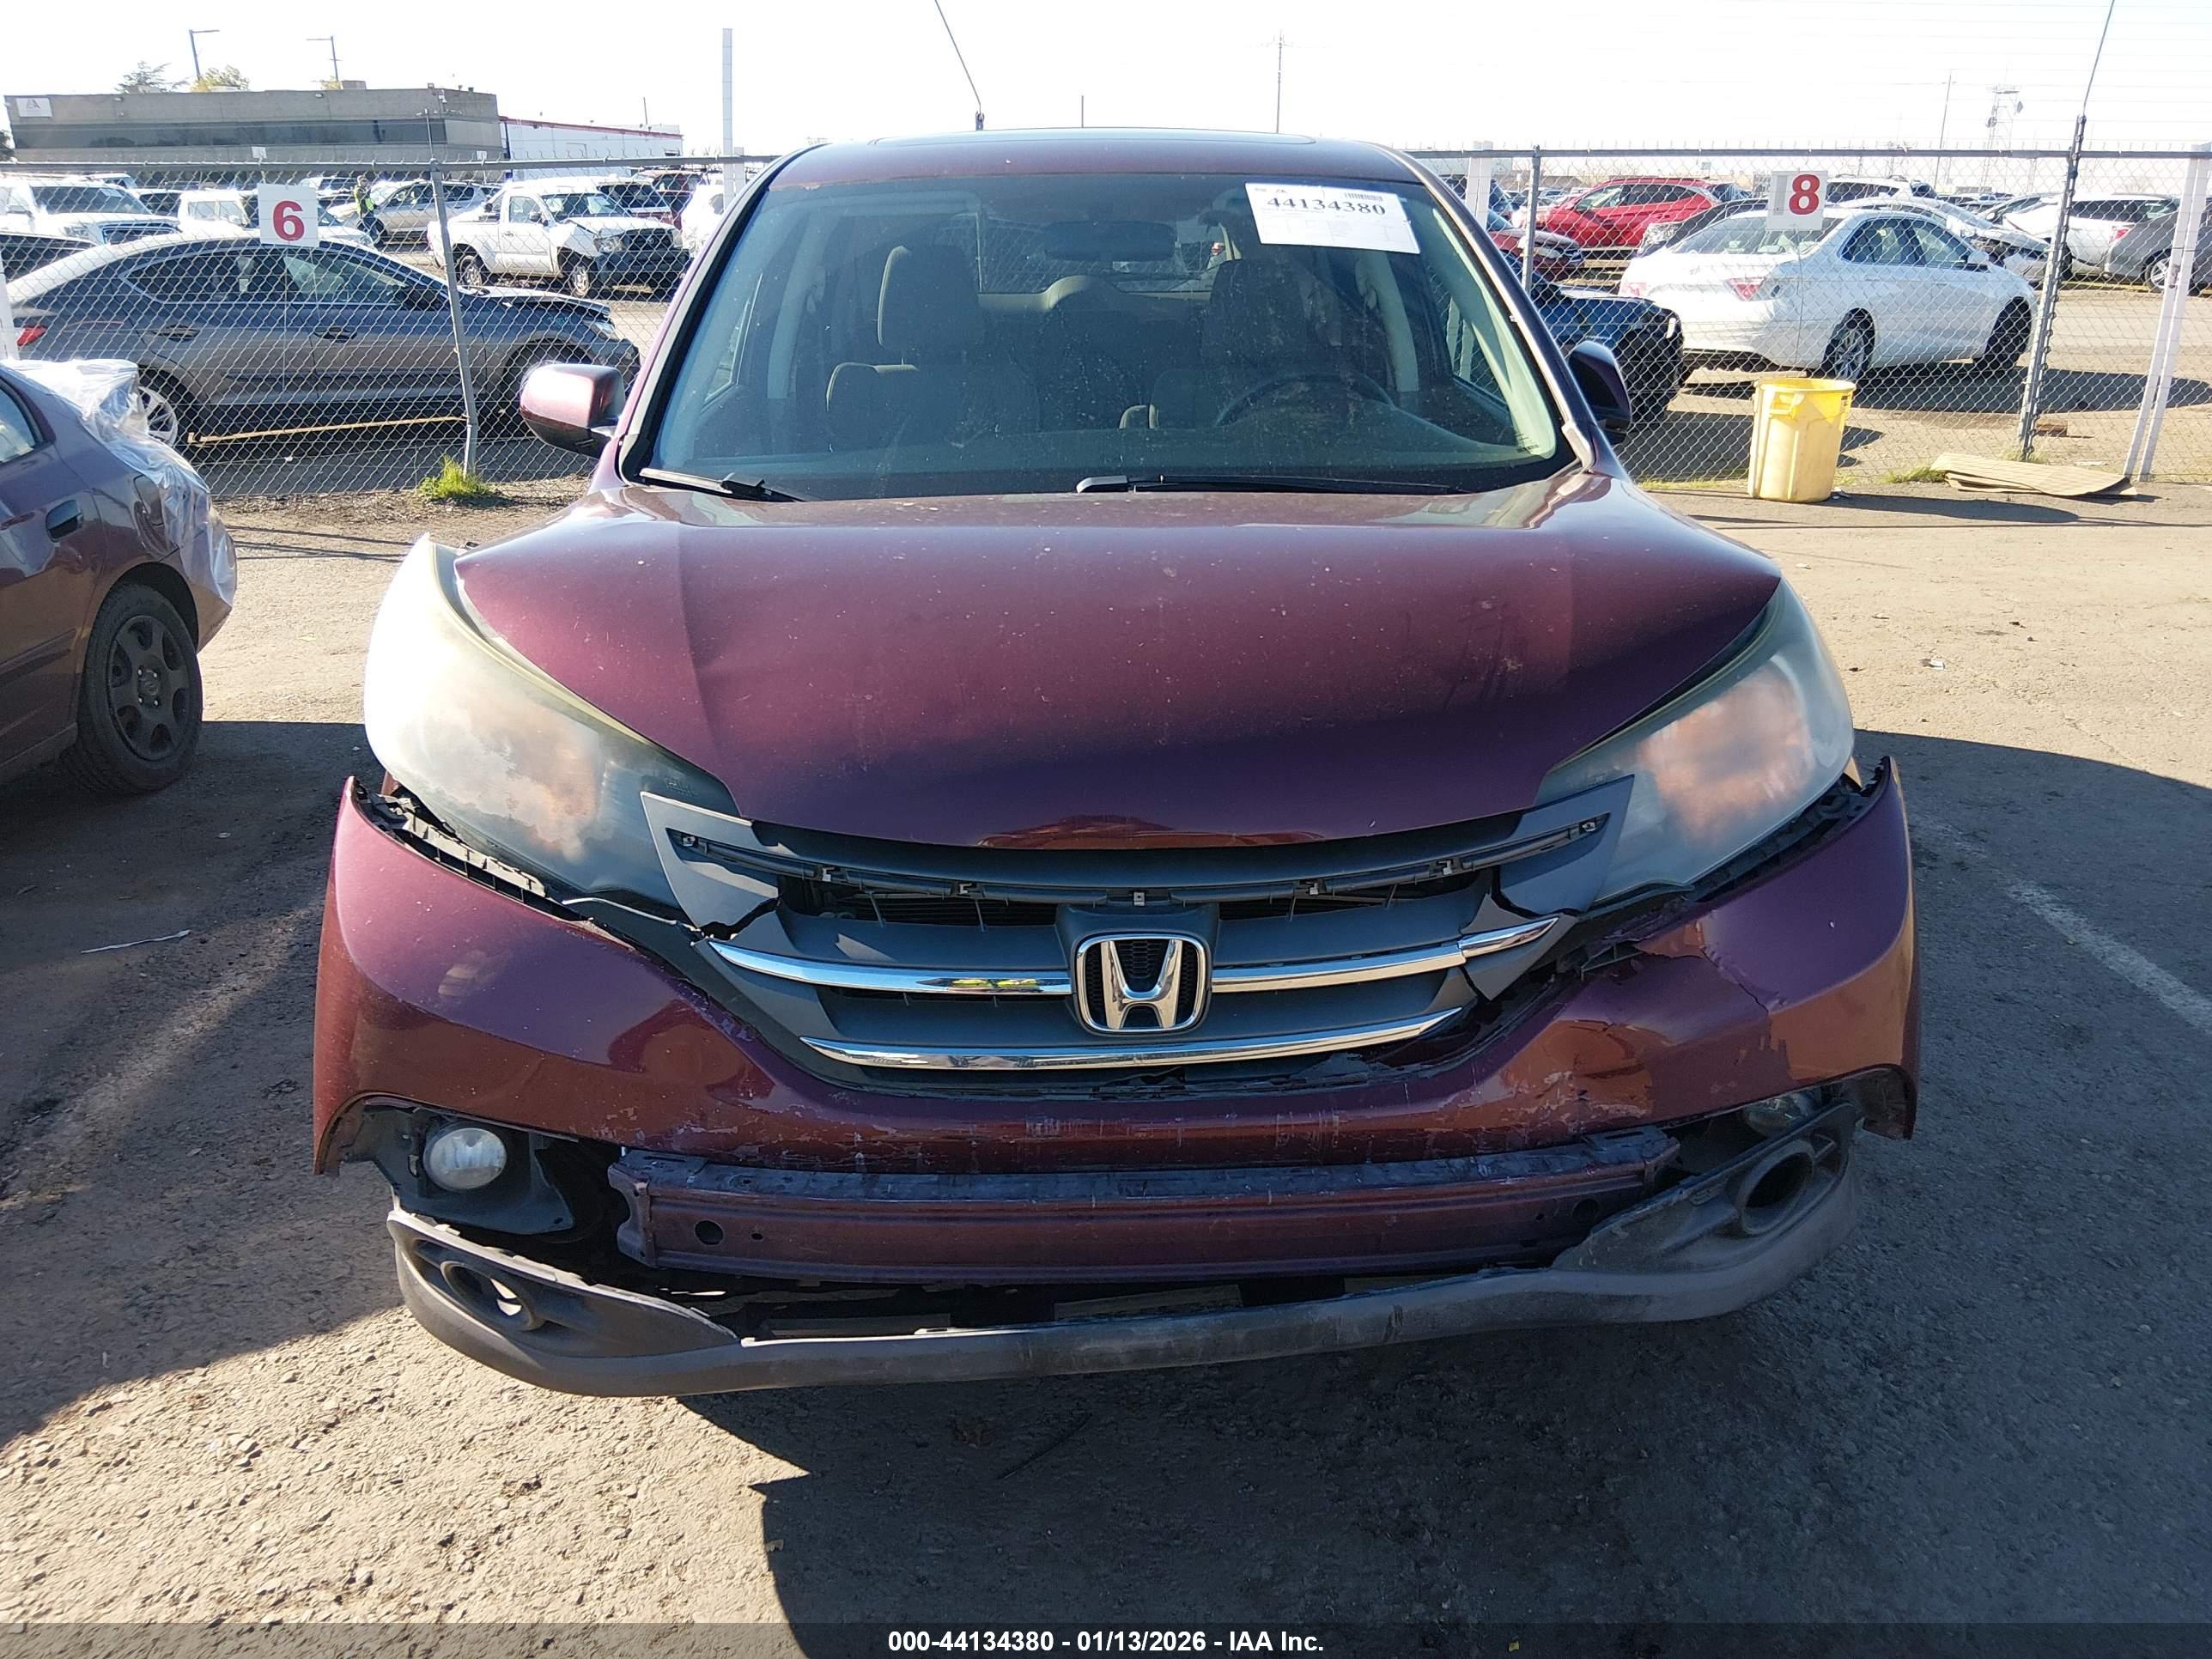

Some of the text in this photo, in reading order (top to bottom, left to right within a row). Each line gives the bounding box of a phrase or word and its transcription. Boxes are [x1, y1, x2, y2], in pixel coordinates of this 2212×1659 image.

[1267, 197, 1386, 215] 44134380
[1789, 173, 1820, 216] 8
[272, 200, 304, 241] 6
